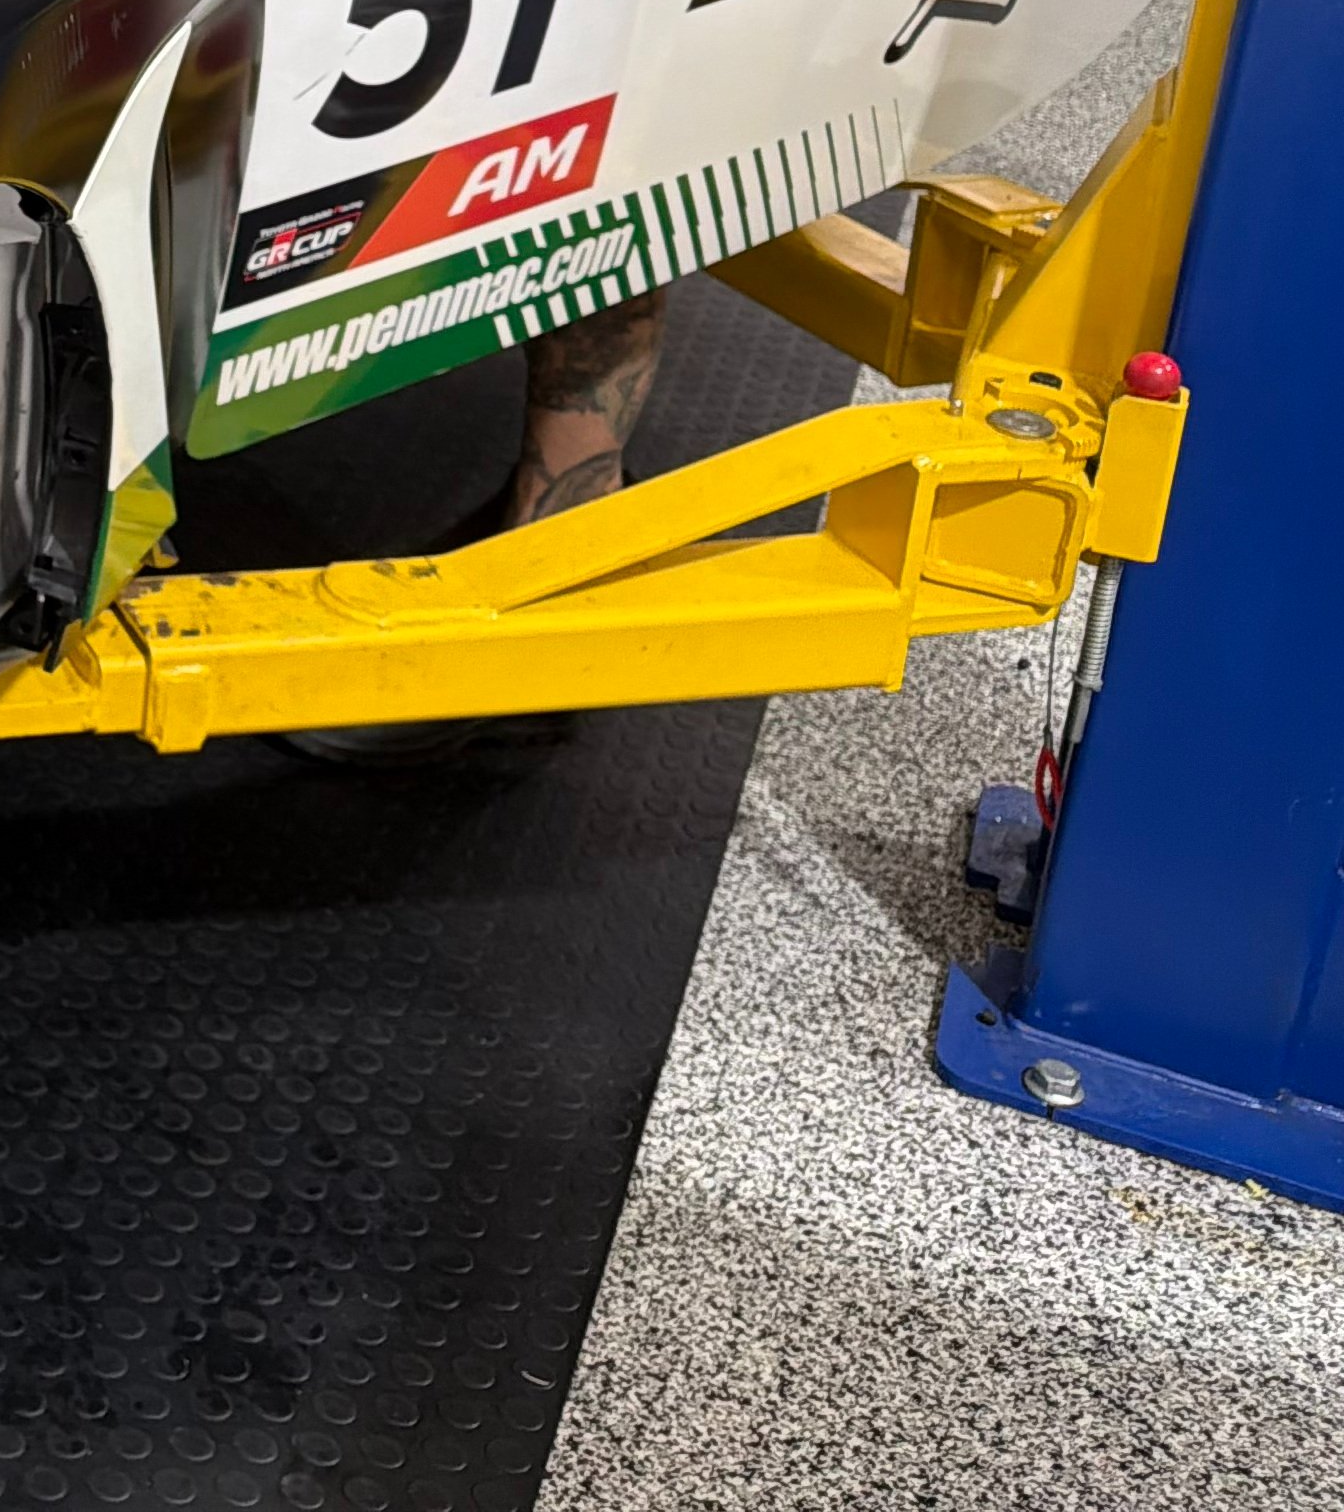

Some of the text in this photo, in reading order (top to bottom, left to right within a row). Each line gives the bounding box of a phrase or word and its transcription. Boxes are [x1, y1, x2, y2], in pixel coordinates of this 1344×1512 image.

[447, 123, 590, 219] AM
[246, 220, 354, 272] GR CUP
[215, 222, 636, 407] www.pennmac.com
